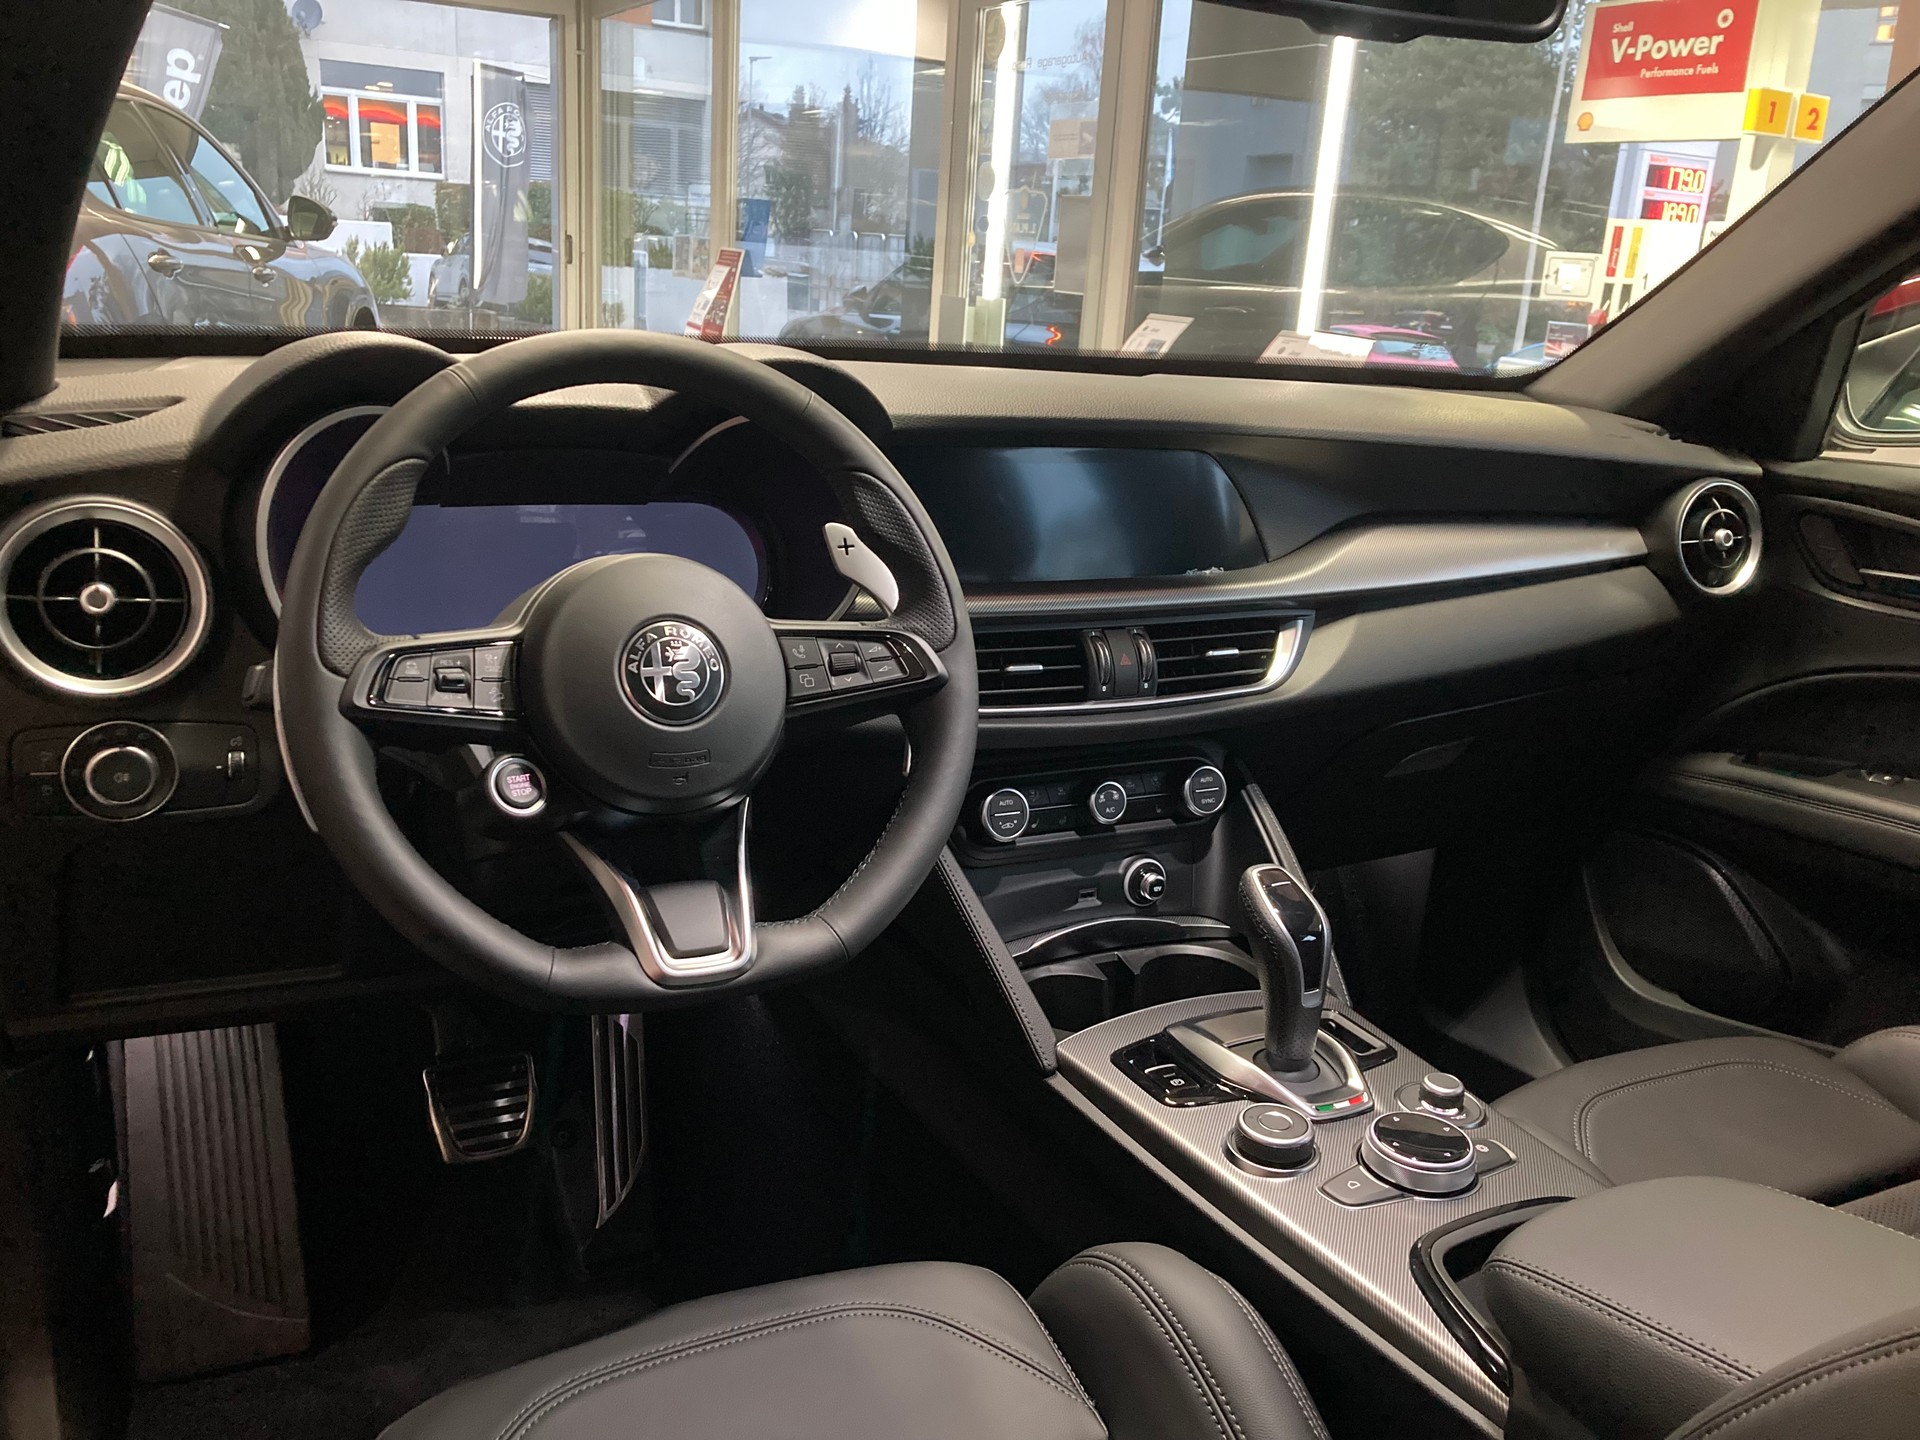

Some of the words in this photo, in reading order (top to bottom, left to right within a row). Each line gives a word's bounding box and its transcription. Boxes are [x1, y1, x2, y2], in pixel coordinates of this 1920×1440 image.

[1612, 21, 1635, 33] Shell
[1611, 34, 1725, 63] V-Power
[163, 47, 202, 110] ep
[1640, 66, 1694, 79] Performance
[1696, 62, 1719, 75] Fuels
[485, 107, 504, 132] ALFA
[1768, 101, 1777, 124] 1
[1806, 107, 1820, 131] 2
[627, 632, 659, 674] ALFA
[663, 625, 720, 672] ROMEO
[506, 773, 531, 784] START
[511, 787, 533, 797] STOP
[999, 799, 1014, 807] AUTO
[1201, 797, 1216, 805] SYNC
[1105, 806, 1116, 814] A/C
